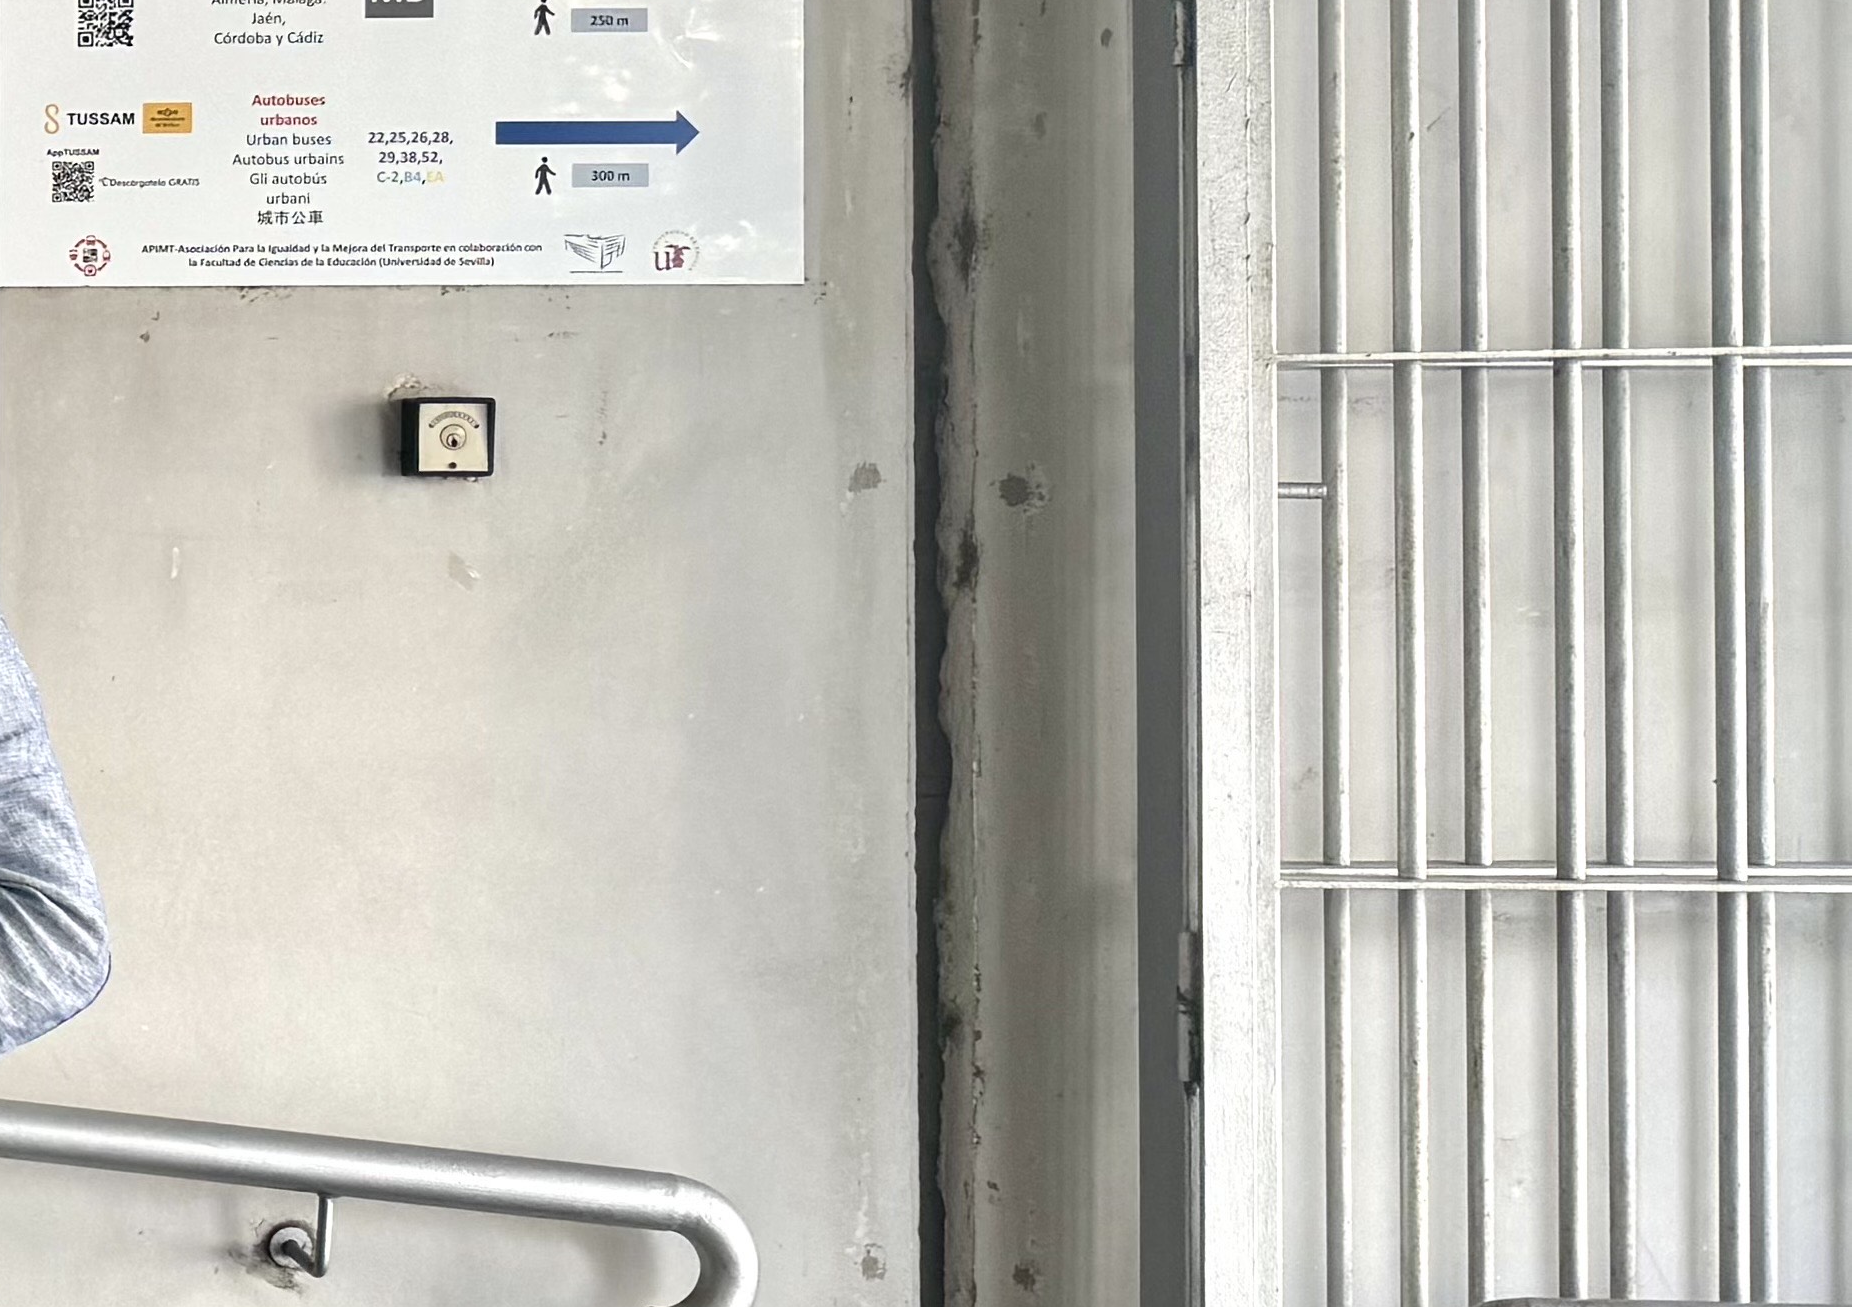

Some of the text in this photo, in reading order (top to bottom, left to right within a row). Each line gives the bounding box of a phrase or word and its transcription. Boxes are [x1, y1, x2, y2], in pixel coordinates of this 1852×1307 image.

[251, 11, 286, 26] Jaén,
[590, 14, 629, 26] 250 m
[213, 30, 324, 47] Córdoba y Cádiz
[251, 93, 326, 107] Autobuses
[66, 112, 136, 126] TUSSAM
[260, 113, 318, 126] urbanos
[246, 132, 332, 146] Urban buses
[232, 152, 345, 166] Autobus urbains
[249, 172, 268, 185] Gli
[591, 170, 630, 182] 300 m
[266, 192, 311, 205] urbani
